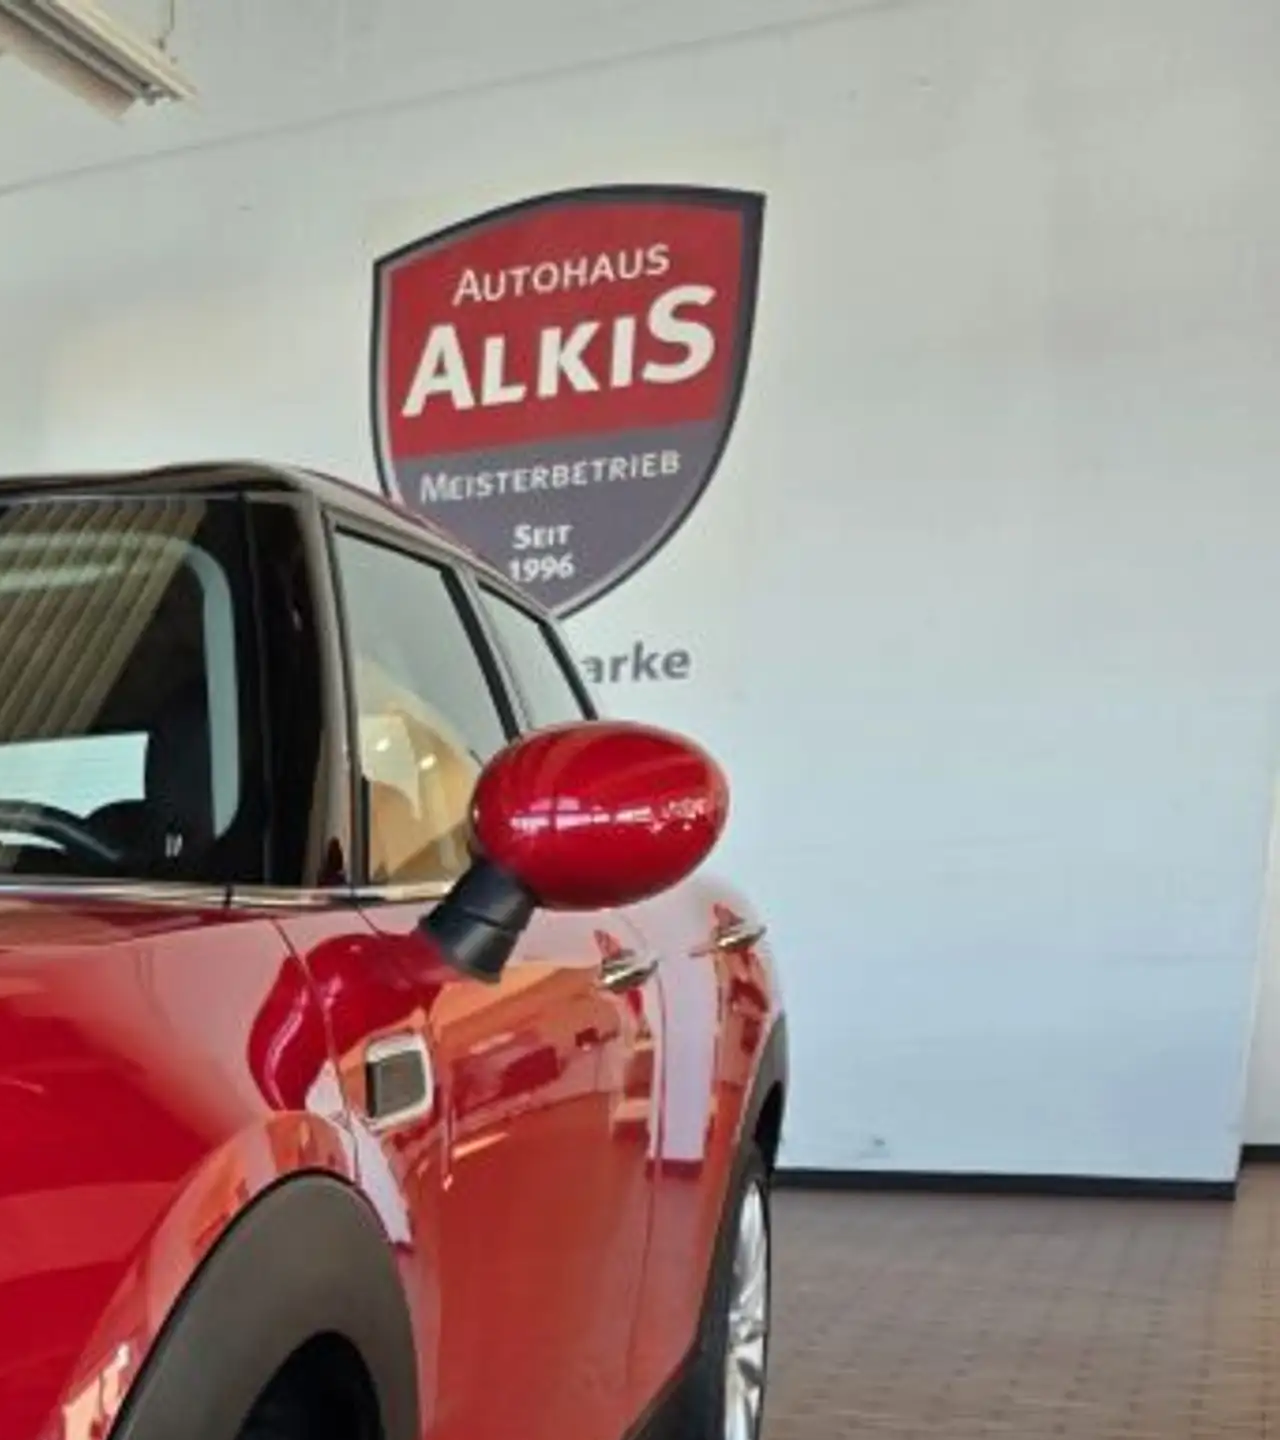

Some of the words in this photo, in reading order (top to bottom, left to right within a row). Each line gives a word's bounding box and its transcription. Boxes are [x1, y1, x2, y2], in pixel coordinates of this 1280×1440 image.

[451, 243, 671, 307] AUTOHAUS
[401, 284, 717, 418] ALKIS
[420, 449, 682, 503] MEISTERBETRIEB
[512, 523, 574, 550] SEIT
[508, 551, 576, 583] 1996
[581, 640, 692, 684] arke
